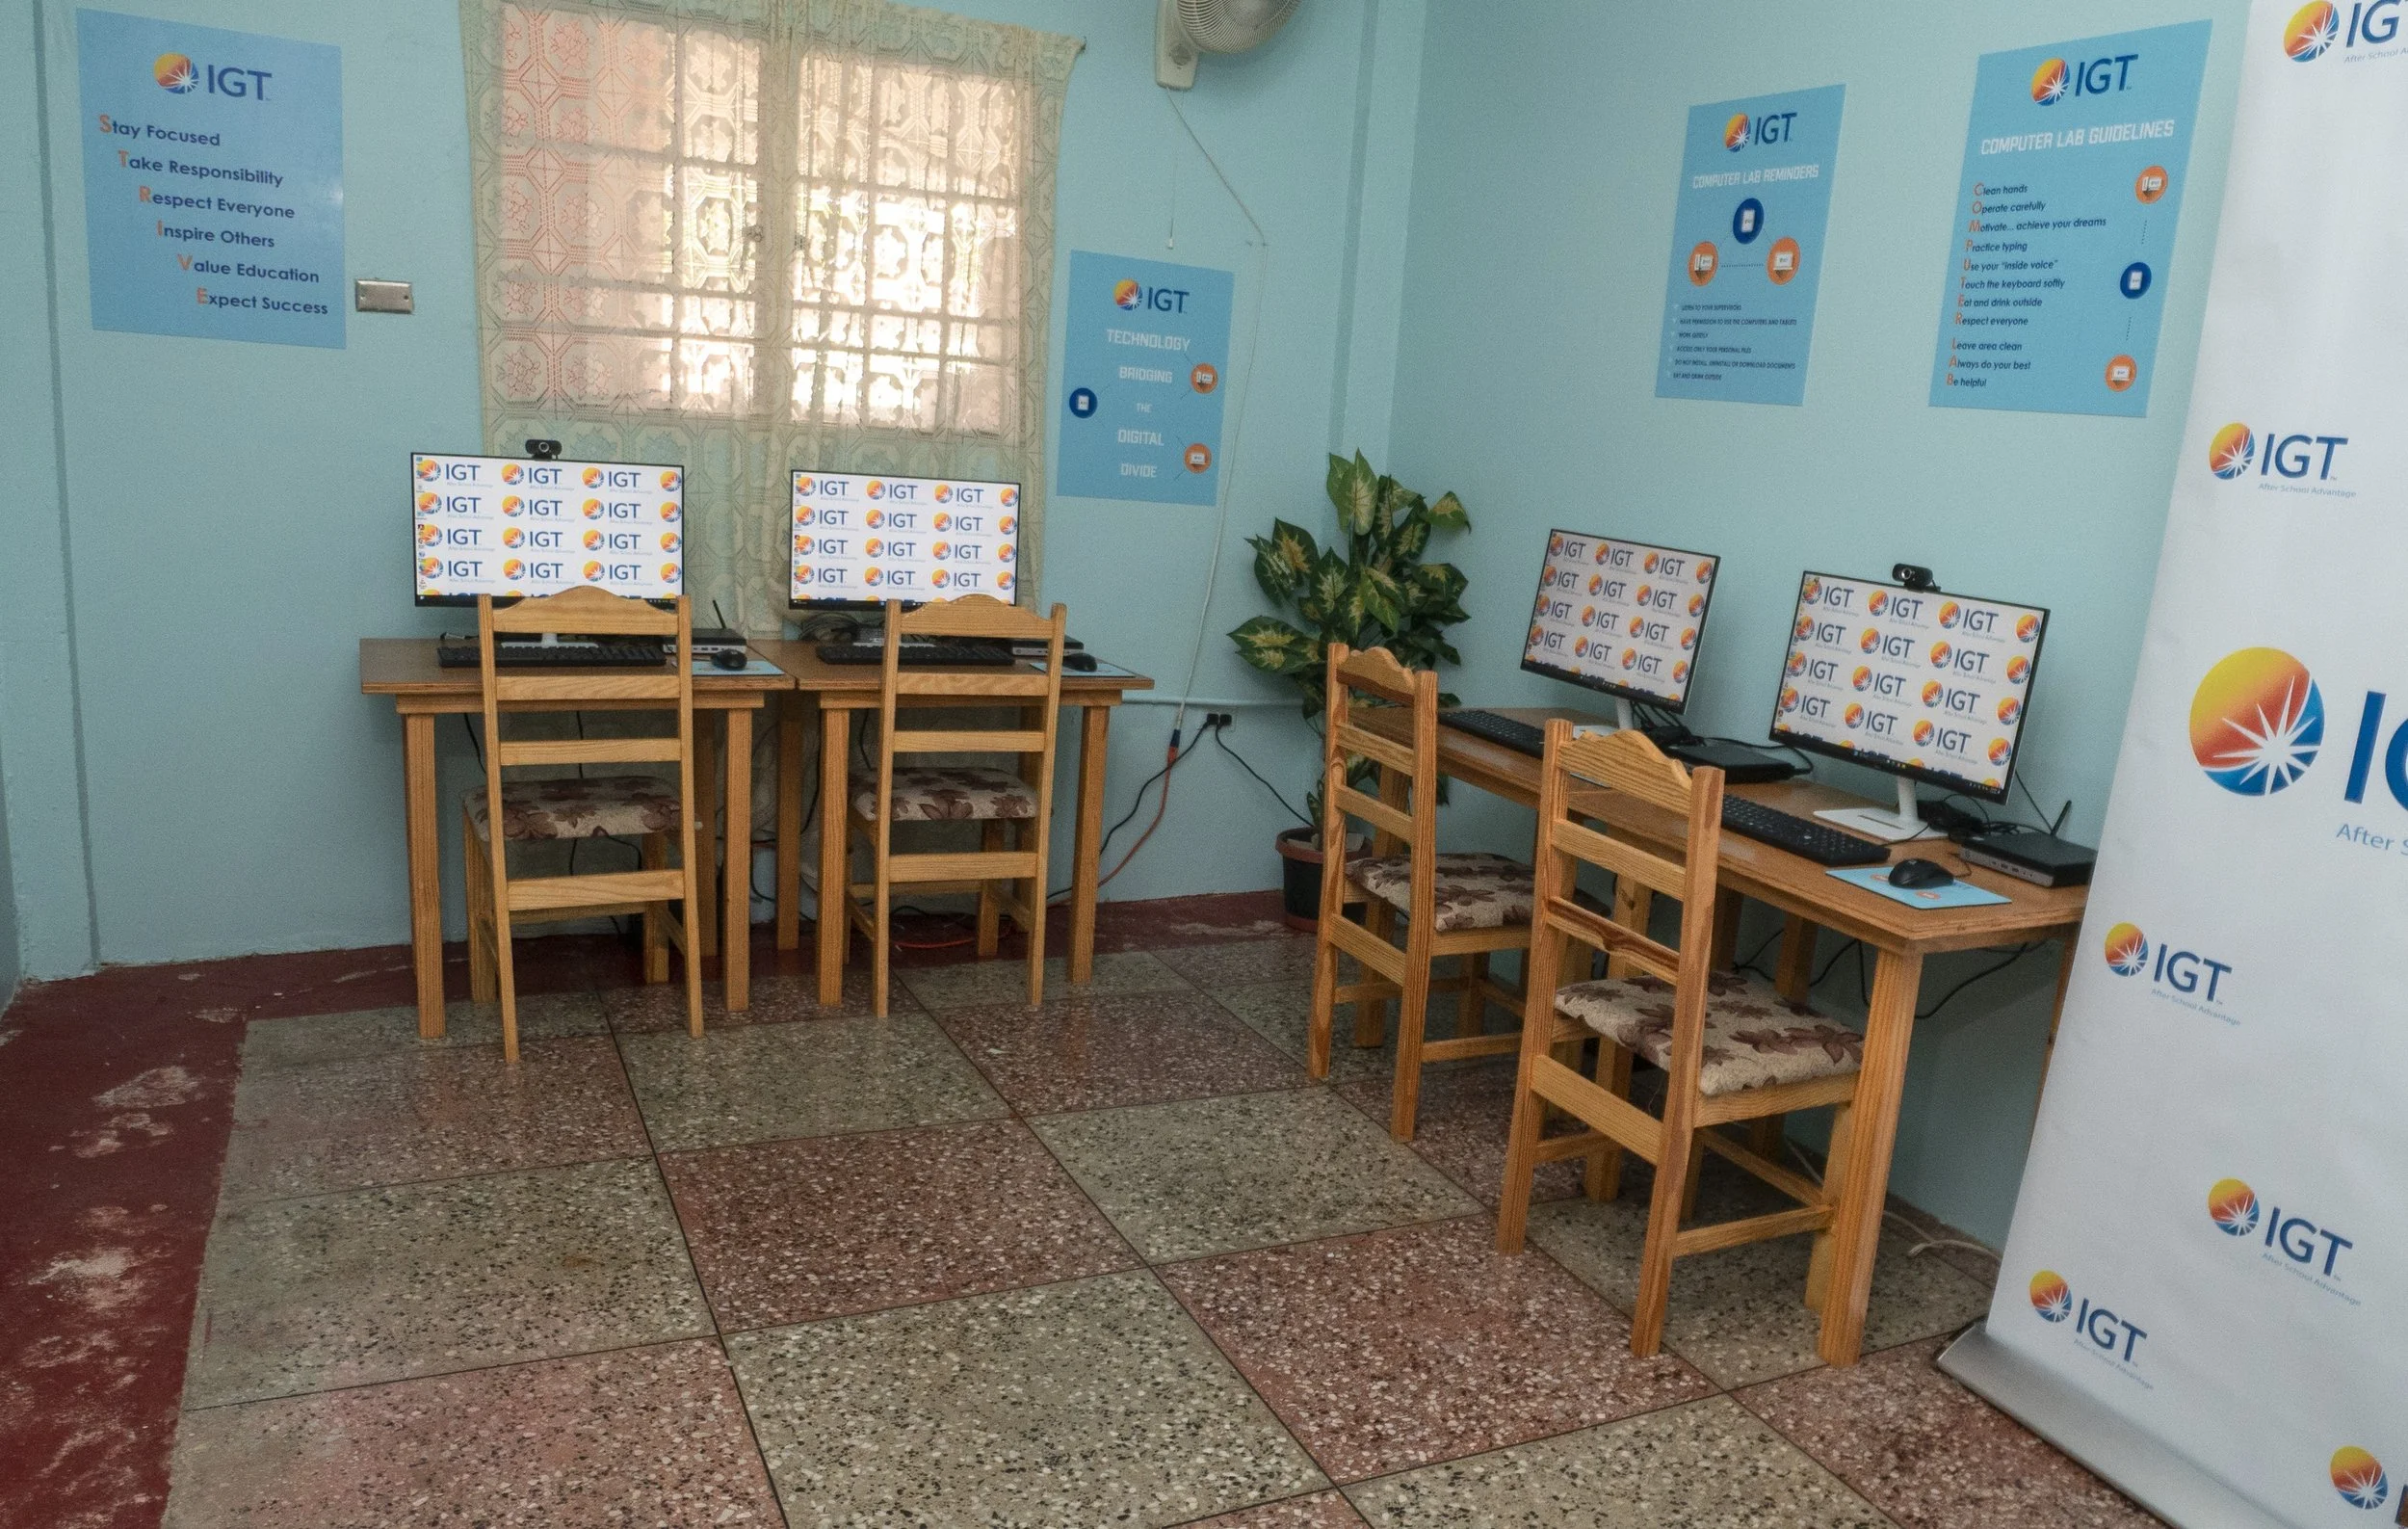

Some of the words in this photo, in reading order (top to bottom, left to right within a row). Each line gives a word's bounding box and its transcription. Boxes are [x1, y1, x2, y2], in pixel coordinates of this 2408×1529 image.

[2346, 0, 2408, 48] IG
[2369, 49, 2397, 59] School
[207, 65, 272, 100] IGT
[2075, 54, 2138, 96] IGT
[98, 114, 141, 139] Stay
[146, 124, 221, 146] Focused
[1754, 113, 1797, 145] IGT
[1981, 133, 2053, 155] COMPUTER
[2057, 129, 2083, 148] LAB
[2088, 119, 2175, 144] GUIDELINES
[118, 150, 163, 172] Take
[170, 161, 283, 187] Responsibility
[1693, 171, 1740, 189] COMPUTER
[1743, 171, 1761, 184] LAB
[1764, 165, 1819, 181] REMINDERS
[1974, 182, 2001, 196] Clean
[2003, 185, 2028, 194] hands
[139, 186, 212, 210] Respect
[218, 198, 295, 219] Everyone
[1973, 200, 2007, 215] Operate
[2010, 201, 2046, 211] carefully
[2017, 221, 2050, 230] achieve
[2052, 221, 2072, 229] your
[2074, 218, 2107, 227] dreams
[157, 221, 215, 243] Inspire
[221, 230, 275, 248] Others
[1965, 240, 2000, 252] Practice
[2002, 242, 2028, 253] typing
[177, 253, 231, 275] Value
[238, 264, 319, 283] Education
[1964, 258, 1979, 271] Use
[1981, 263, 1999, 273] your
[1961, 277, 1984, 289] Touch
[2002, 279, 2042, 289] keyboard
[2044, 278, 2065, 289] softly
[196, 287, 257, 308] Expect
[262, 297, 328, 314] Success
[1148, 287, 1190, 314] IGT
[1957, 293, 1972, 307] Eat
[2013, 298, 2042, 306] outside
[1955, 311, 1988, 326] Respect
[1991, 317, 2028, 327] everyone
[1107, 329, 1191, 351] TECHNOLOGY
[1951, 337, 1976, 351] Leave
[1949, 355, 1978, 370] Always
[1994, 361, 2011, 370] your
[1119, 366, 1172, 383] BRIDGING
[1947, 373, 1958, 386] Be
[1960, 378, 1987, 388] helpful
[1137, 402, 1152, 413] THE
[1117, 430, 1165, 446] DIGITAL
[2261, 434, 2348, 480] IGT
[446, 463, 481, 481] IGT
[529, 467, 562, 485] IGT
[1121, 463, 1157, 477] DIVIDE
[609, 471, 641, 488] IGT
[820, 480, 850, 496] IGT
[889, 485, 918, 499] IGT
[956, 488, 984, 503] IGT
[2312, 488, 2356, 498] Advantage
[447, 496, 481, 513] IGT
[530, 499, 563, 515] IGT
[609, 503, 641, 518] IGT
[820, 510, 849, 525] IGT
[889, 514, 917, 528] IGT
[955, 516, 982, 531] IGT
[448, 529, 482, 545] IGT
[530, 532, 563, 548] IGT
[609, 534, 641, 549] IGT
[819, 539, 848, 554] IGT
[888, 542, 916, 557] IGT
[955, 545, 982, 559] IGT
[1564, 541, 1586, 559] IGT
[1610, 548, 1634, 567] IGT
[448, 561, 483, 577] IGT
[531, 563, 563, 579] IGT
[610, 565, 641, 580] IGT
[818, 568, 848, 583] IGT
[1661, 558, 1685, 576] IGT
[887, 570, 915, 585] IGT
[954, 572, 981, 587] IGT
[1557, 571, 1579, 589] IGT
[1604, 580, 1626, 598] IGT
[1824, 586, 1854, 608] IGT
[1653, 591, 1677, 609] IGT
[1891, 596, 1924, 620] IGT
[1551, 602, 1572, 620] IGT
[1596, 612, 1619, 630] IGT
[1963, 610, 1999, 633] IGT
[1544, 632, 1565, 649] IGT
[1645, 622, 1669, 642] IGT
[1816, 623, 1846, 646] IGT
[1589, 643, 1611, 661] IGT
[1882, 634, 1915, 658] IGT
[1637, 655, 1662, 674] IGT
[1954, 648, 1989, 673] IGT
[1808, 659, 1838, 681] IGT
[1874, 673, 1906, 697] IGT
[1801, 695, 1830, 718] IGT
[1945, 688, 1980, 713] IGT
[1866, 710, 1898, 735] IGT
[1936, 727, 1972, 752] IGT
[2336, 824, 2395, 850] After
[2154, 943, 2232, 1001] IGT
[2152, 989, 2169, 999] After
[2265, 1206, 2353, 1277] IGT
[2077, 1298, 2147, 1362] IGT
